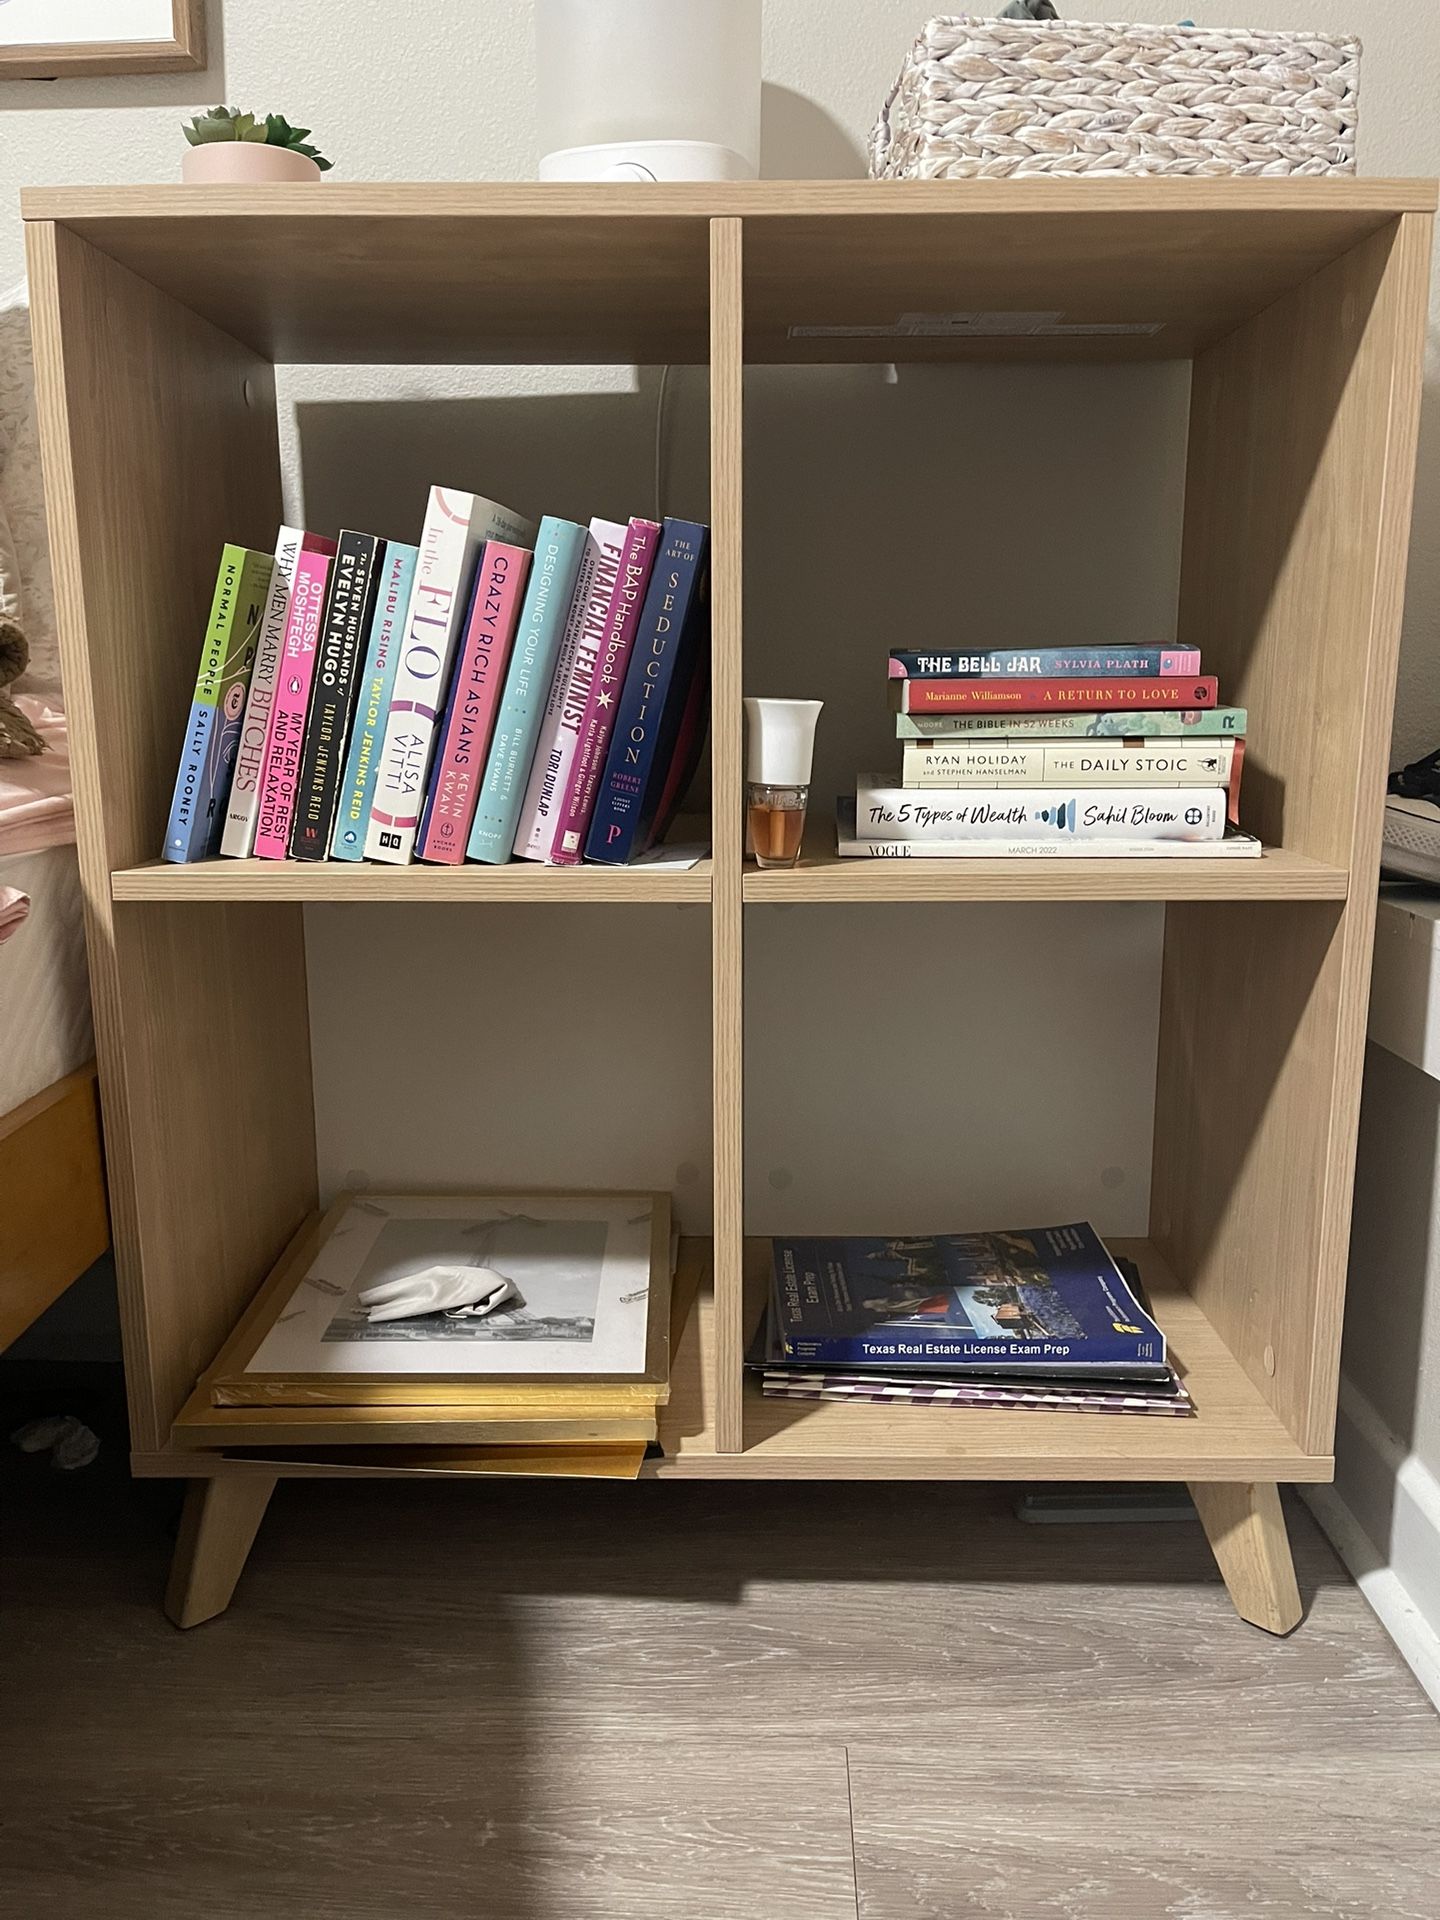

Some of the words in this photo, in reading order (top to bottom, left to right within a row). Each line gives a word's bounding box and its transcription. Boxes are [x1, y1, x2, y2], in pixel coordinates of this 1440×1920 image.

[427, 528, 444, 543] In
[629, 536, 646, 560] The
[674, 540, 690, 550] THE
[277, 542, 297, 583] WHY
[421, 549, 439, 575] the
[585, 548, 591, 556] TO
[665, 549, 682, 560] ART
[683, 553, 695, 562] OF
[386, 558, 403, 613] MALIBU
[533, 544, 559, 623] DESIGNING
[580, 558, 588, 583] MASTER
[581, 560, 595, 602] OVERCOME
[622, 563, 643, 601] BAP
[216, 565, 235, 630] NORMAL
[270, 584, 289, 622] MEN
[331, 554, 355, 626] EVELYN
[351, 569, 365, 611] SEVEN
[483, 557, 508, 627] CRAZY
[582, 542, 622, 640] FINANCIAL
[287, 571, 311, 659] MOSHFEGH
[301, 582, 323, 653] OTTESSA
[569, 604, 578, 626] MONEY
[578, 604, 586, 618] THE
[376, 619, 393, 669] RISING
[405, 580, 453, 679] FLO
[600, 602, 632, 684] Handbook
[258, 624, 282, 684] MARRY
[322, 631, 343, 686] HUGO
[339, 616, 358, 685] HUSBANDS
[471, 633, 493, 684] RICH
[524, 629, 541, 665] YOUR
[203, 639, 221, 695] PEOPLE
[624, 572, 679, 764] SEDUCTION
[917, 656, 951, 673] THE
[958, 656, 1000, 673] BELL
[1007, 656, 1042, 673] JAR
[1055, 660, 1100, 669] SYLVIA
[1107, 659, 1149, 669] PLATH
[516, 668, 531, 697] LIFE
[561, 645, 599, 735] FEMINIST
[926, 691, 967, 701] Marianne
[971, 690, 1022, 701] Williamson
[1043, 691, 1052, 701] A
[1058, 690, 1113, 701] RETURN
[1118, 690, 1136, 700] TO
[1142, 690, 1179, 700] LOVE
[366, 677, 384, 726] TAYLOR
[192, 710, 208, 755] SALLY
[274, 709, 289, 742] AND
[290, 712, 303, 736] MY
[320, 703, 336, 741] TAYLOR
[455, 688, 481, 764] ASIANS
[512, 728, 522, 747] BILL
[588, 719, 598, 736] Karla
[953, 720, 973, 729] THE
[977, 719, 1006, 729] BIBLE
[1010, 719, 1021, 728] IN
[1024, 719, 1035, 728] 52
[1040, 718, 1074, 728] WEEKS
[236, 687, 273, 793] BITCHES
[498, 734, 508, 760] DAVE
[581, 737, 593, 766] Lightfoot
[282, 739, 300, 779] YEAR
[312, 745, 329, 792] JENKINS
[355, 730, 373, 786] JENKINS
[385, 735, 409, 790] VITTI
[401, 734, 424, 794] ALISA
[503, 750, 517, 792] BURNETT
[547, 749, 562, 772] TORI
[926, 756, 960, 764] RYAN
[967, 755, 1027, 764] HOLIDAY
[1054, 761, 1074, 769] THE
[1081, 759, 1129, 771] DAILY
[1136, 759, 1187, 771] STOIC
[259, 745, 284, 838] RELAXATION
[279, 781, 293, 803] OF
[440, 770, 456, 815] KWAN
[490, 762, 502, 793] EVANS
[574, 773, 586, 795] Ginger
[584, 774, 596, 795] Tracey
[610, 781, 640, 794] GREENE
[612, 772, 641, 784] ROBERT
[178, 764, 198, 826] ROONEY
[308, 795, 322, 821] REID
[350, 790, 363, 820] REID
[453, 772, 470, 819] KEVIN
[538, 773, 556, 817] DUNLAP
[569, 795, 580, 817] Wilson
[273, 805, 290, 843] REST
[870, 806, 895, 823] The
[898, 804, 912, 822] 5
[914, 807, 953, 828] Types
[956, 807, 969, 823] of
[970, 804, 1027, 824] Wealth
[1083, 805, 1126, 826] Sahil
[1130, 805, 1178, 825] Bloom
[479, 830, 502, 839] KNOPF
[868, 845, 911, 857] VOGUE
[783, 1249, 796, 1273] License
[785, 1273, 799, 1291] Estate
[803, 1271, 816, 1286] Prep
[786, 1291, 800, 1307] Real
[805, 1286, 819, 1303] Exam
[789, 1307, 803, 1322] Texas
[862, 1344, 895, 1354] Texas
[898, 1344, 922, 1354] Real
[926, 1344, 960, 1354] Estate
[964, 1344, 1007, 1354] License
[1010, 1344, 1041, 1354] Exam
[1044, 1344, 1070, 1356] Prep
